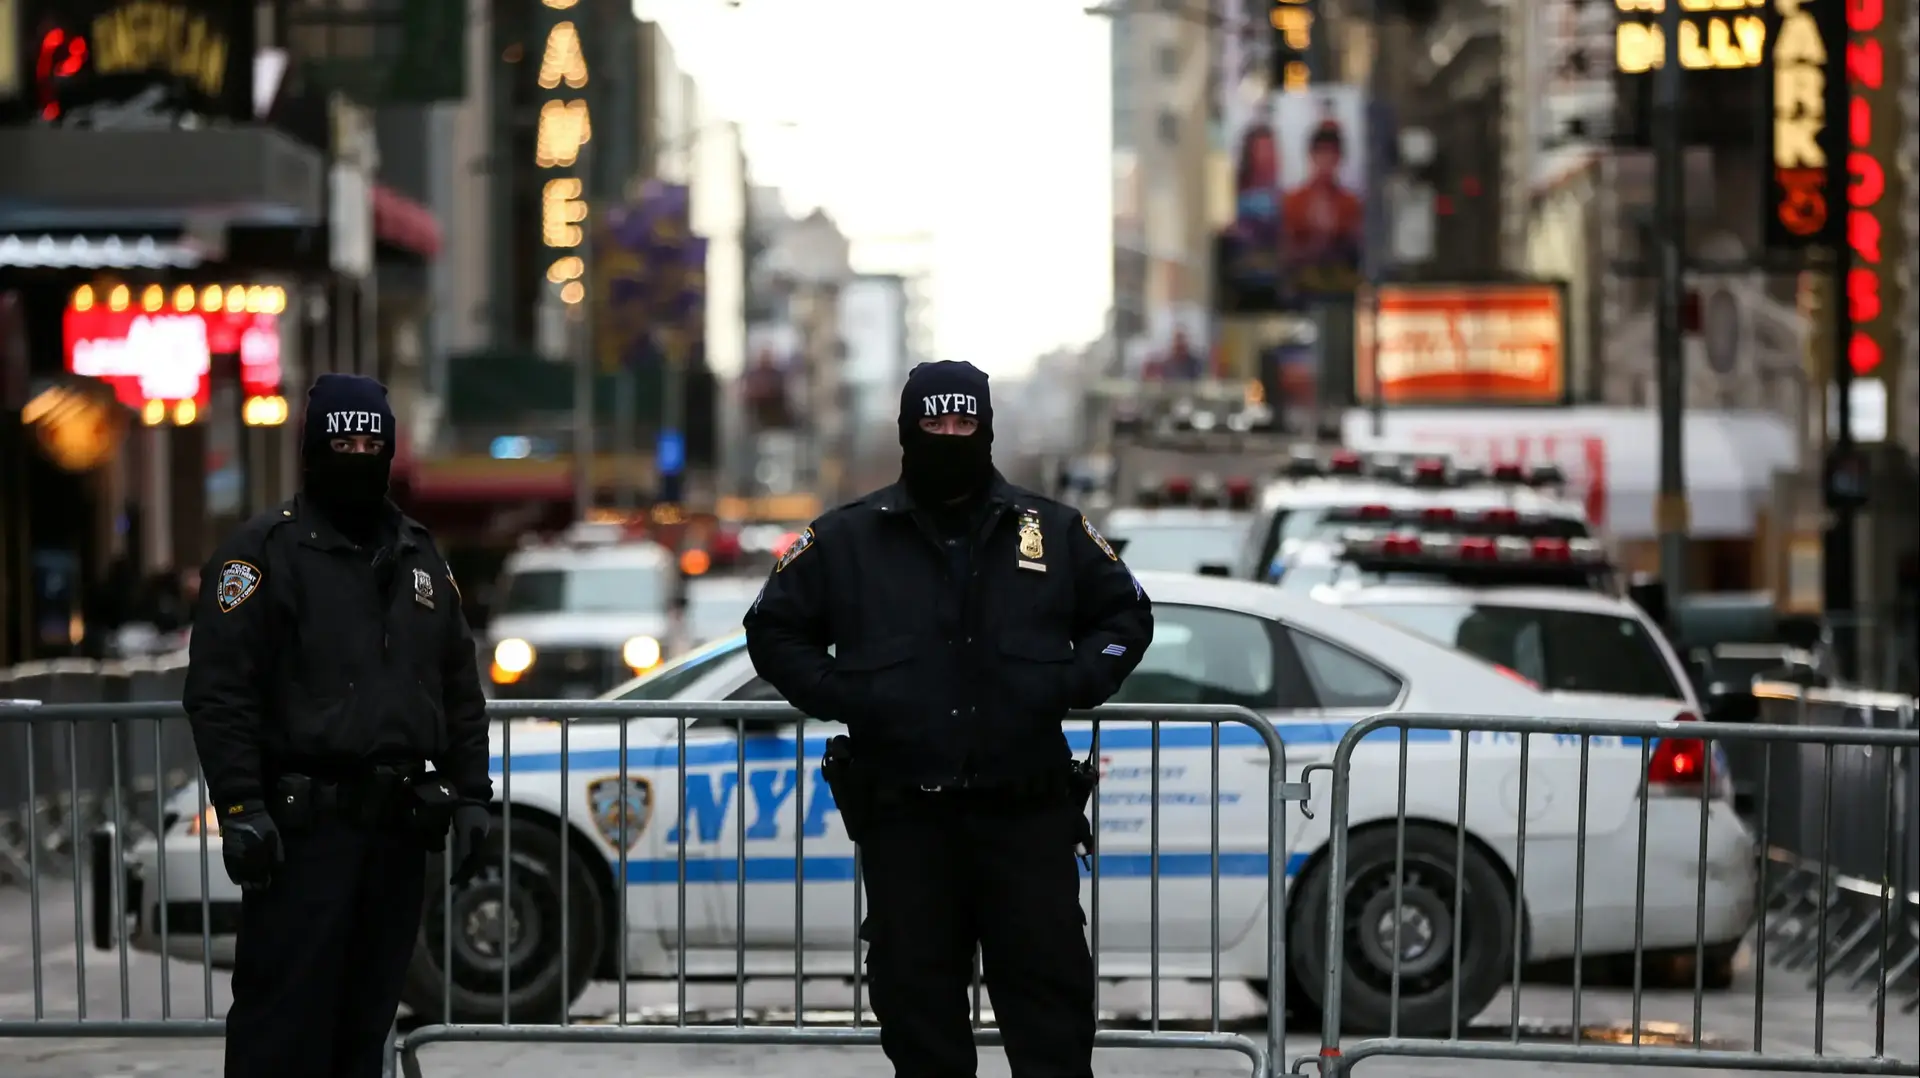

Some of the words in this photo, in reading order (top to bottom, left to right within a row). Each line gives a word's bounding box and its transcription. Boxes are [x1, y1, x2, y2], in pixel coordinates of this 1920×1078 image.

[923, 393, 977, 416] NYPD
[326, 411, 381, 433] NYPD
[231, 563, 251, 573] POLICE
[666, 768, 840, 844] NYP
